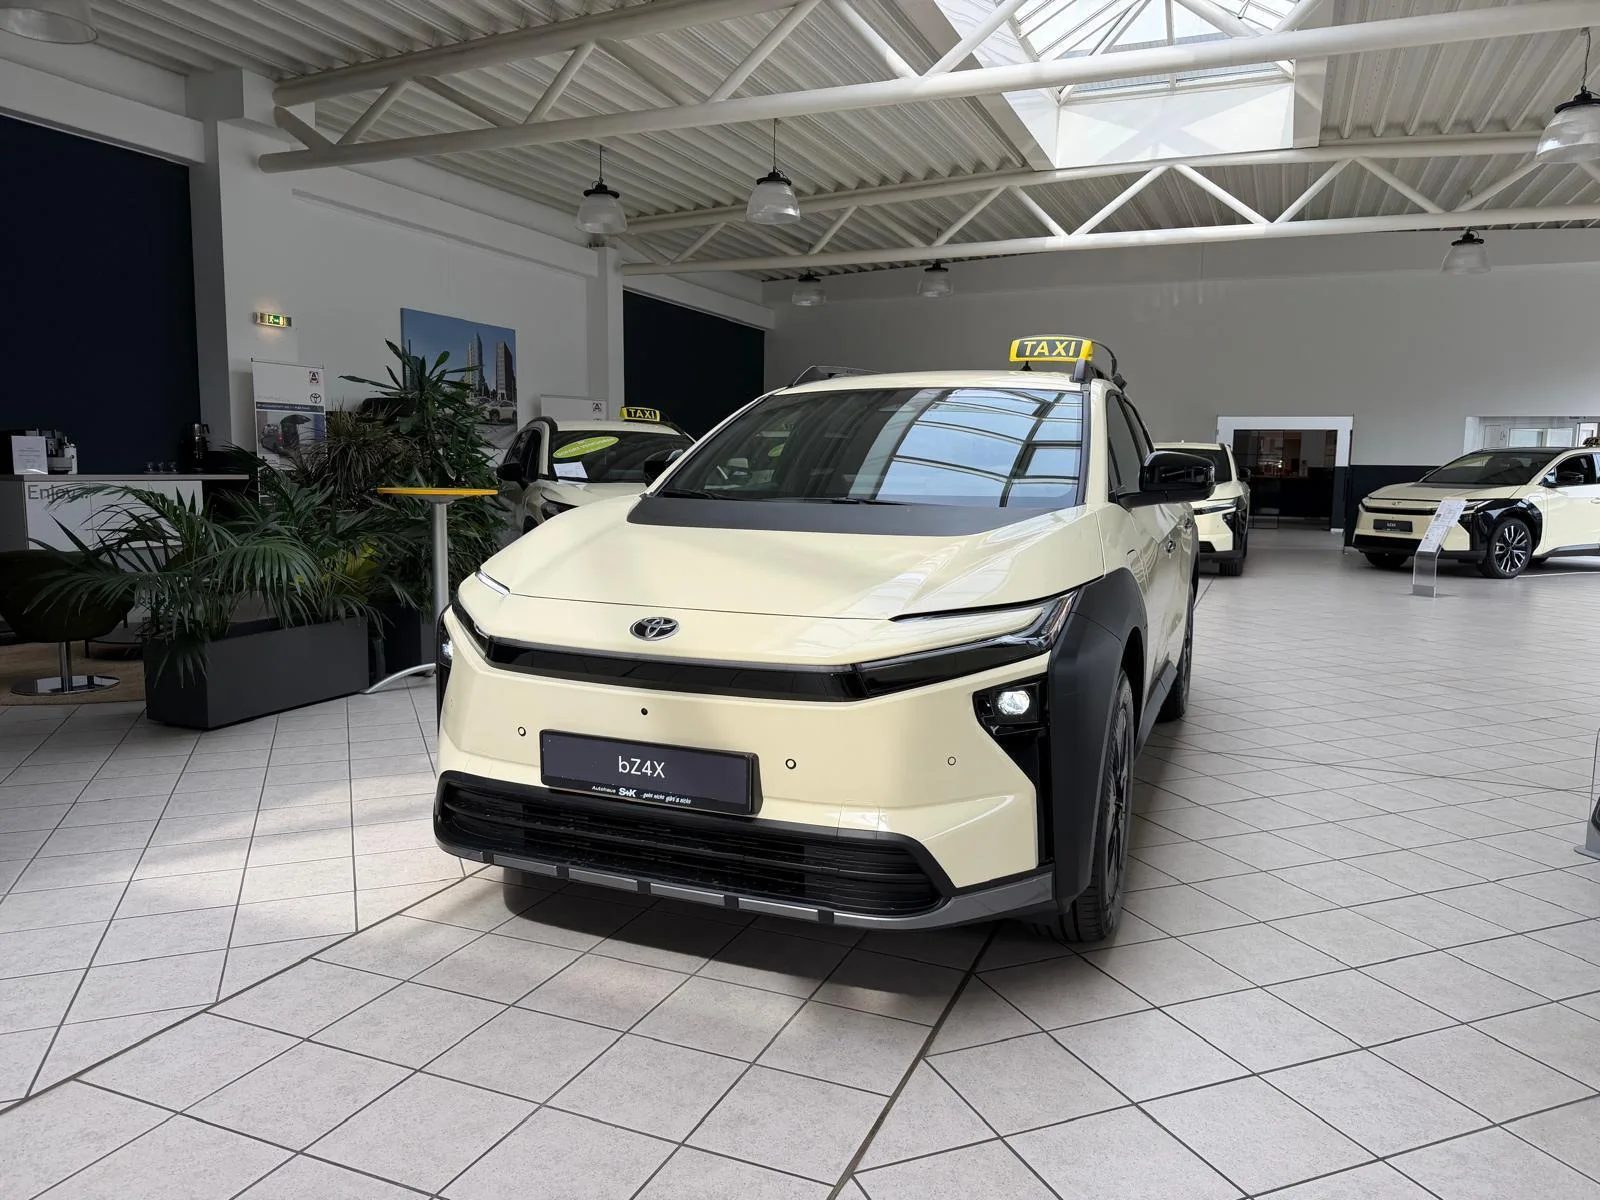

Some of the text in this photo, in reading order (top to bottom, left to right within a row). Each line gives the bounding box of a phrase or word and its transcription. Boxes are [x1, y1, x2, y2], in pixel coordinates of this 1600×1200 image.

[1023, 341, 1076, 356] TAXI
[629, 409, 655, 419] TAXI
[618, 756, 665, 778] bZ4X
[592, 785, 616, 793] Autohaus
[618, 787, 637, 797] S+K
